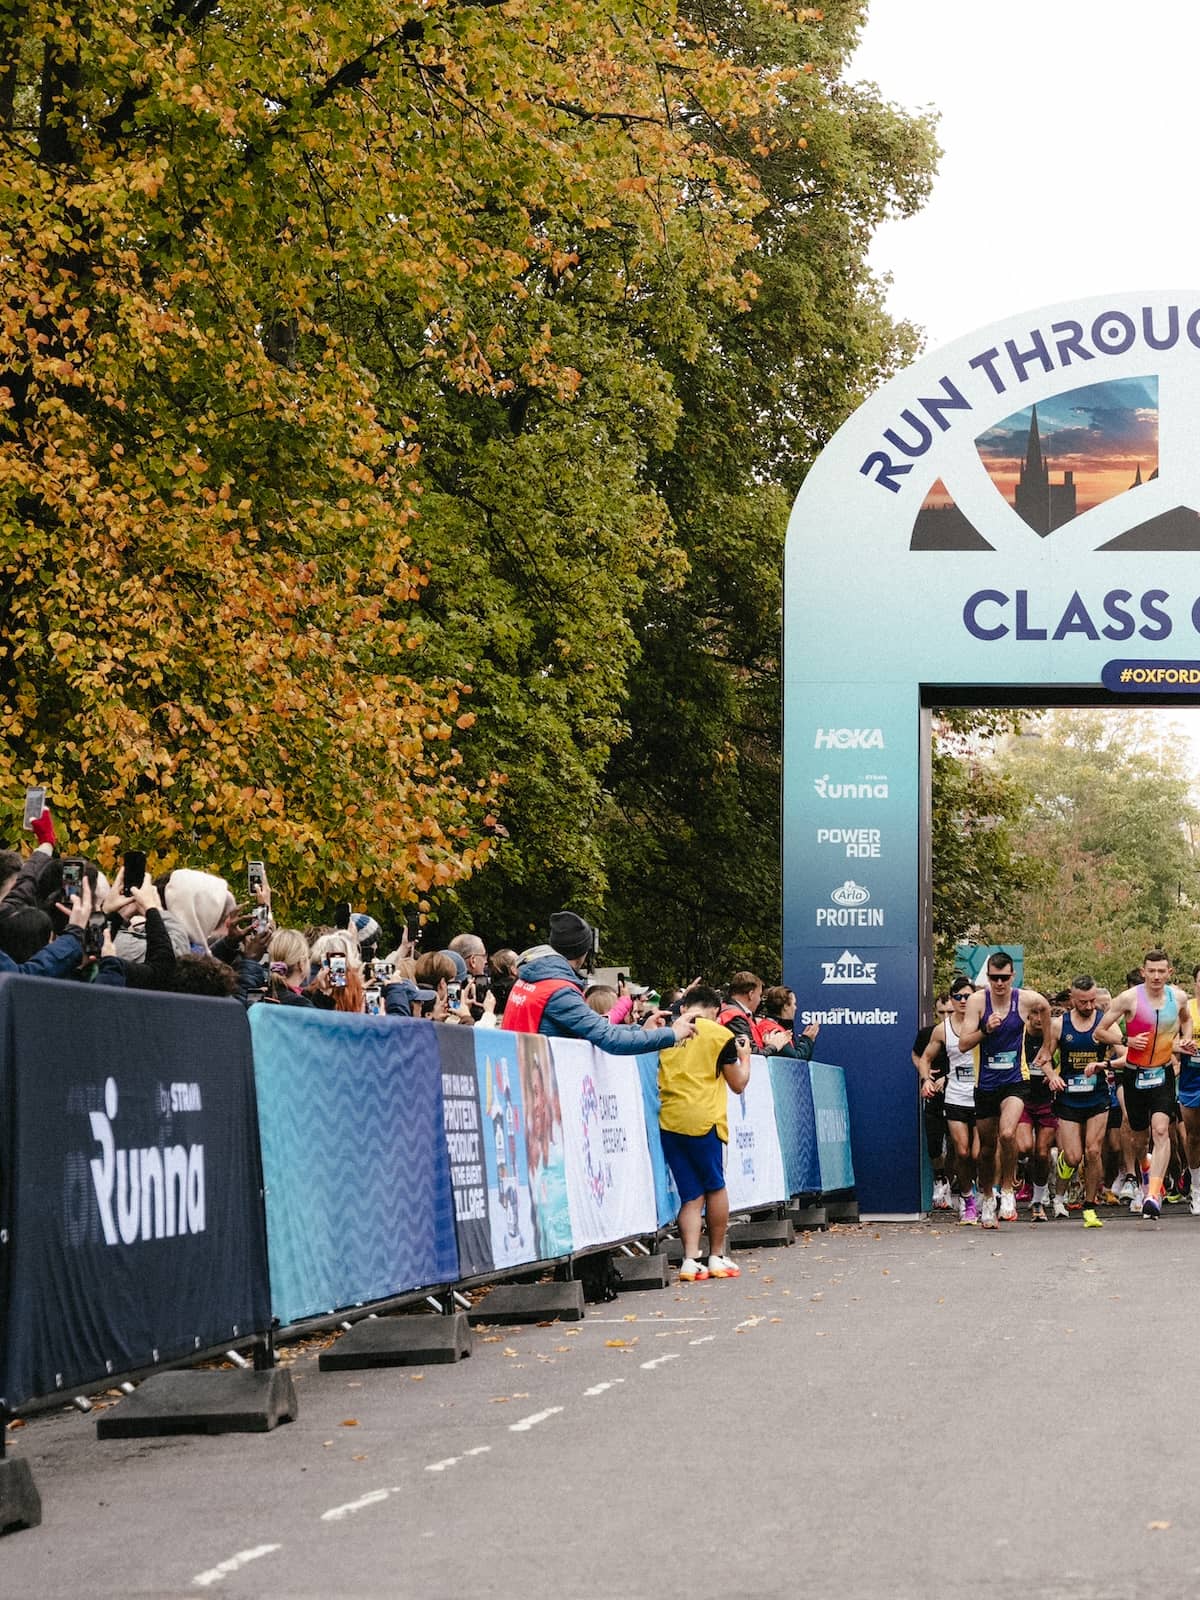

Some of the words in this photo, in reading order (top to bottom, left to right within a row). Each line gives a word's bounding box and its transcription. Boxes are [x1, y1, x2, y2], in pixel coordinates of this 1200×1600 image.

[859, 375, 974, 493] RUN
[962, 589, 1173, 641] CLASS
[814, 728, 884, 749] HOKA
[814, 774, 889, 798] Runna
[817, 829, 881, 843] POWER
[846, 844, 881, 857] ADE
[837, 889, 863, 901] Arla
[816, 908, 884, 927] PROTEIN
[821, 961, 879, 980] TRIBE
[88, 1076, 206, 1246] Runna
